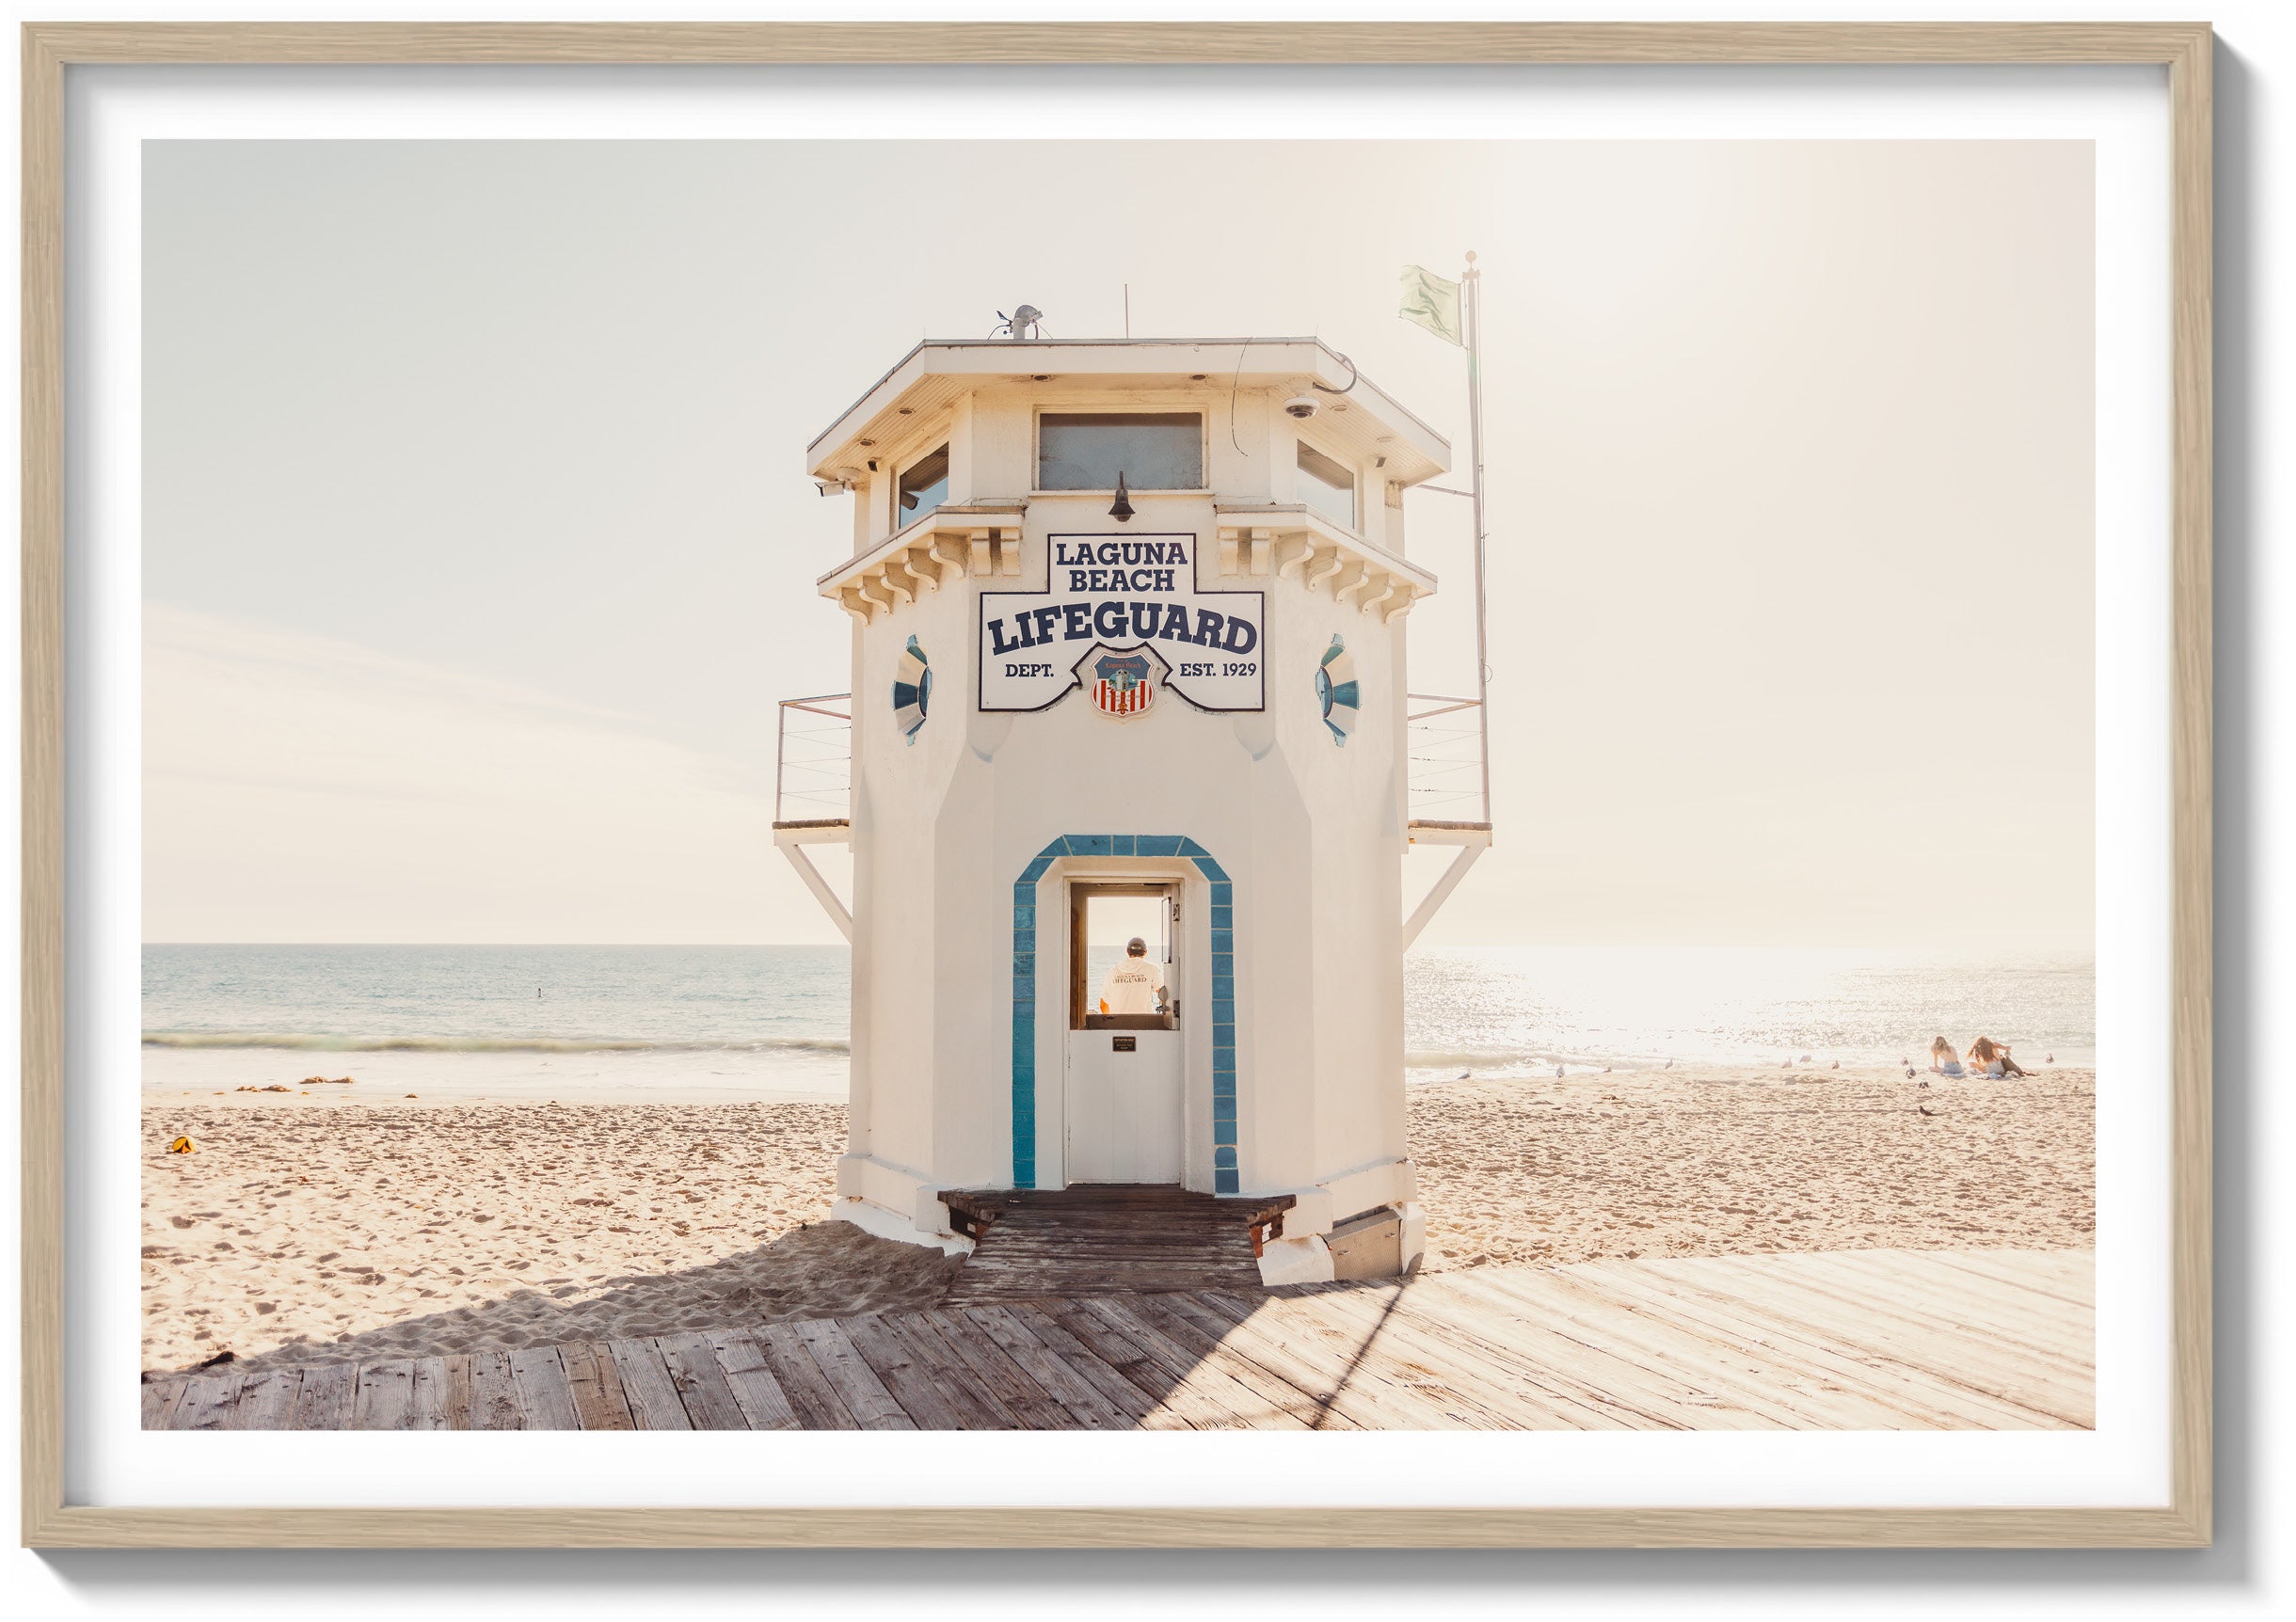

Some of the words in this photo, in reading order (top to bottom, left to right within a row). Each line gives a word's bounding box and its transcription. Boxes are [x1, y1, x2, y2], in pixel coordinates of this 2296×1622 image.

[1056, 543, 1188, 566] LAGUNA
[1069, 569, 1175, 593] BEACH
[987, 601, 1258, 656] LIFEGUARD
[1005, 663, 1055, 677] DEPT.
[1180, 662, 1217, 676] EST.
[1222, 662, 1257, 676] 1929
